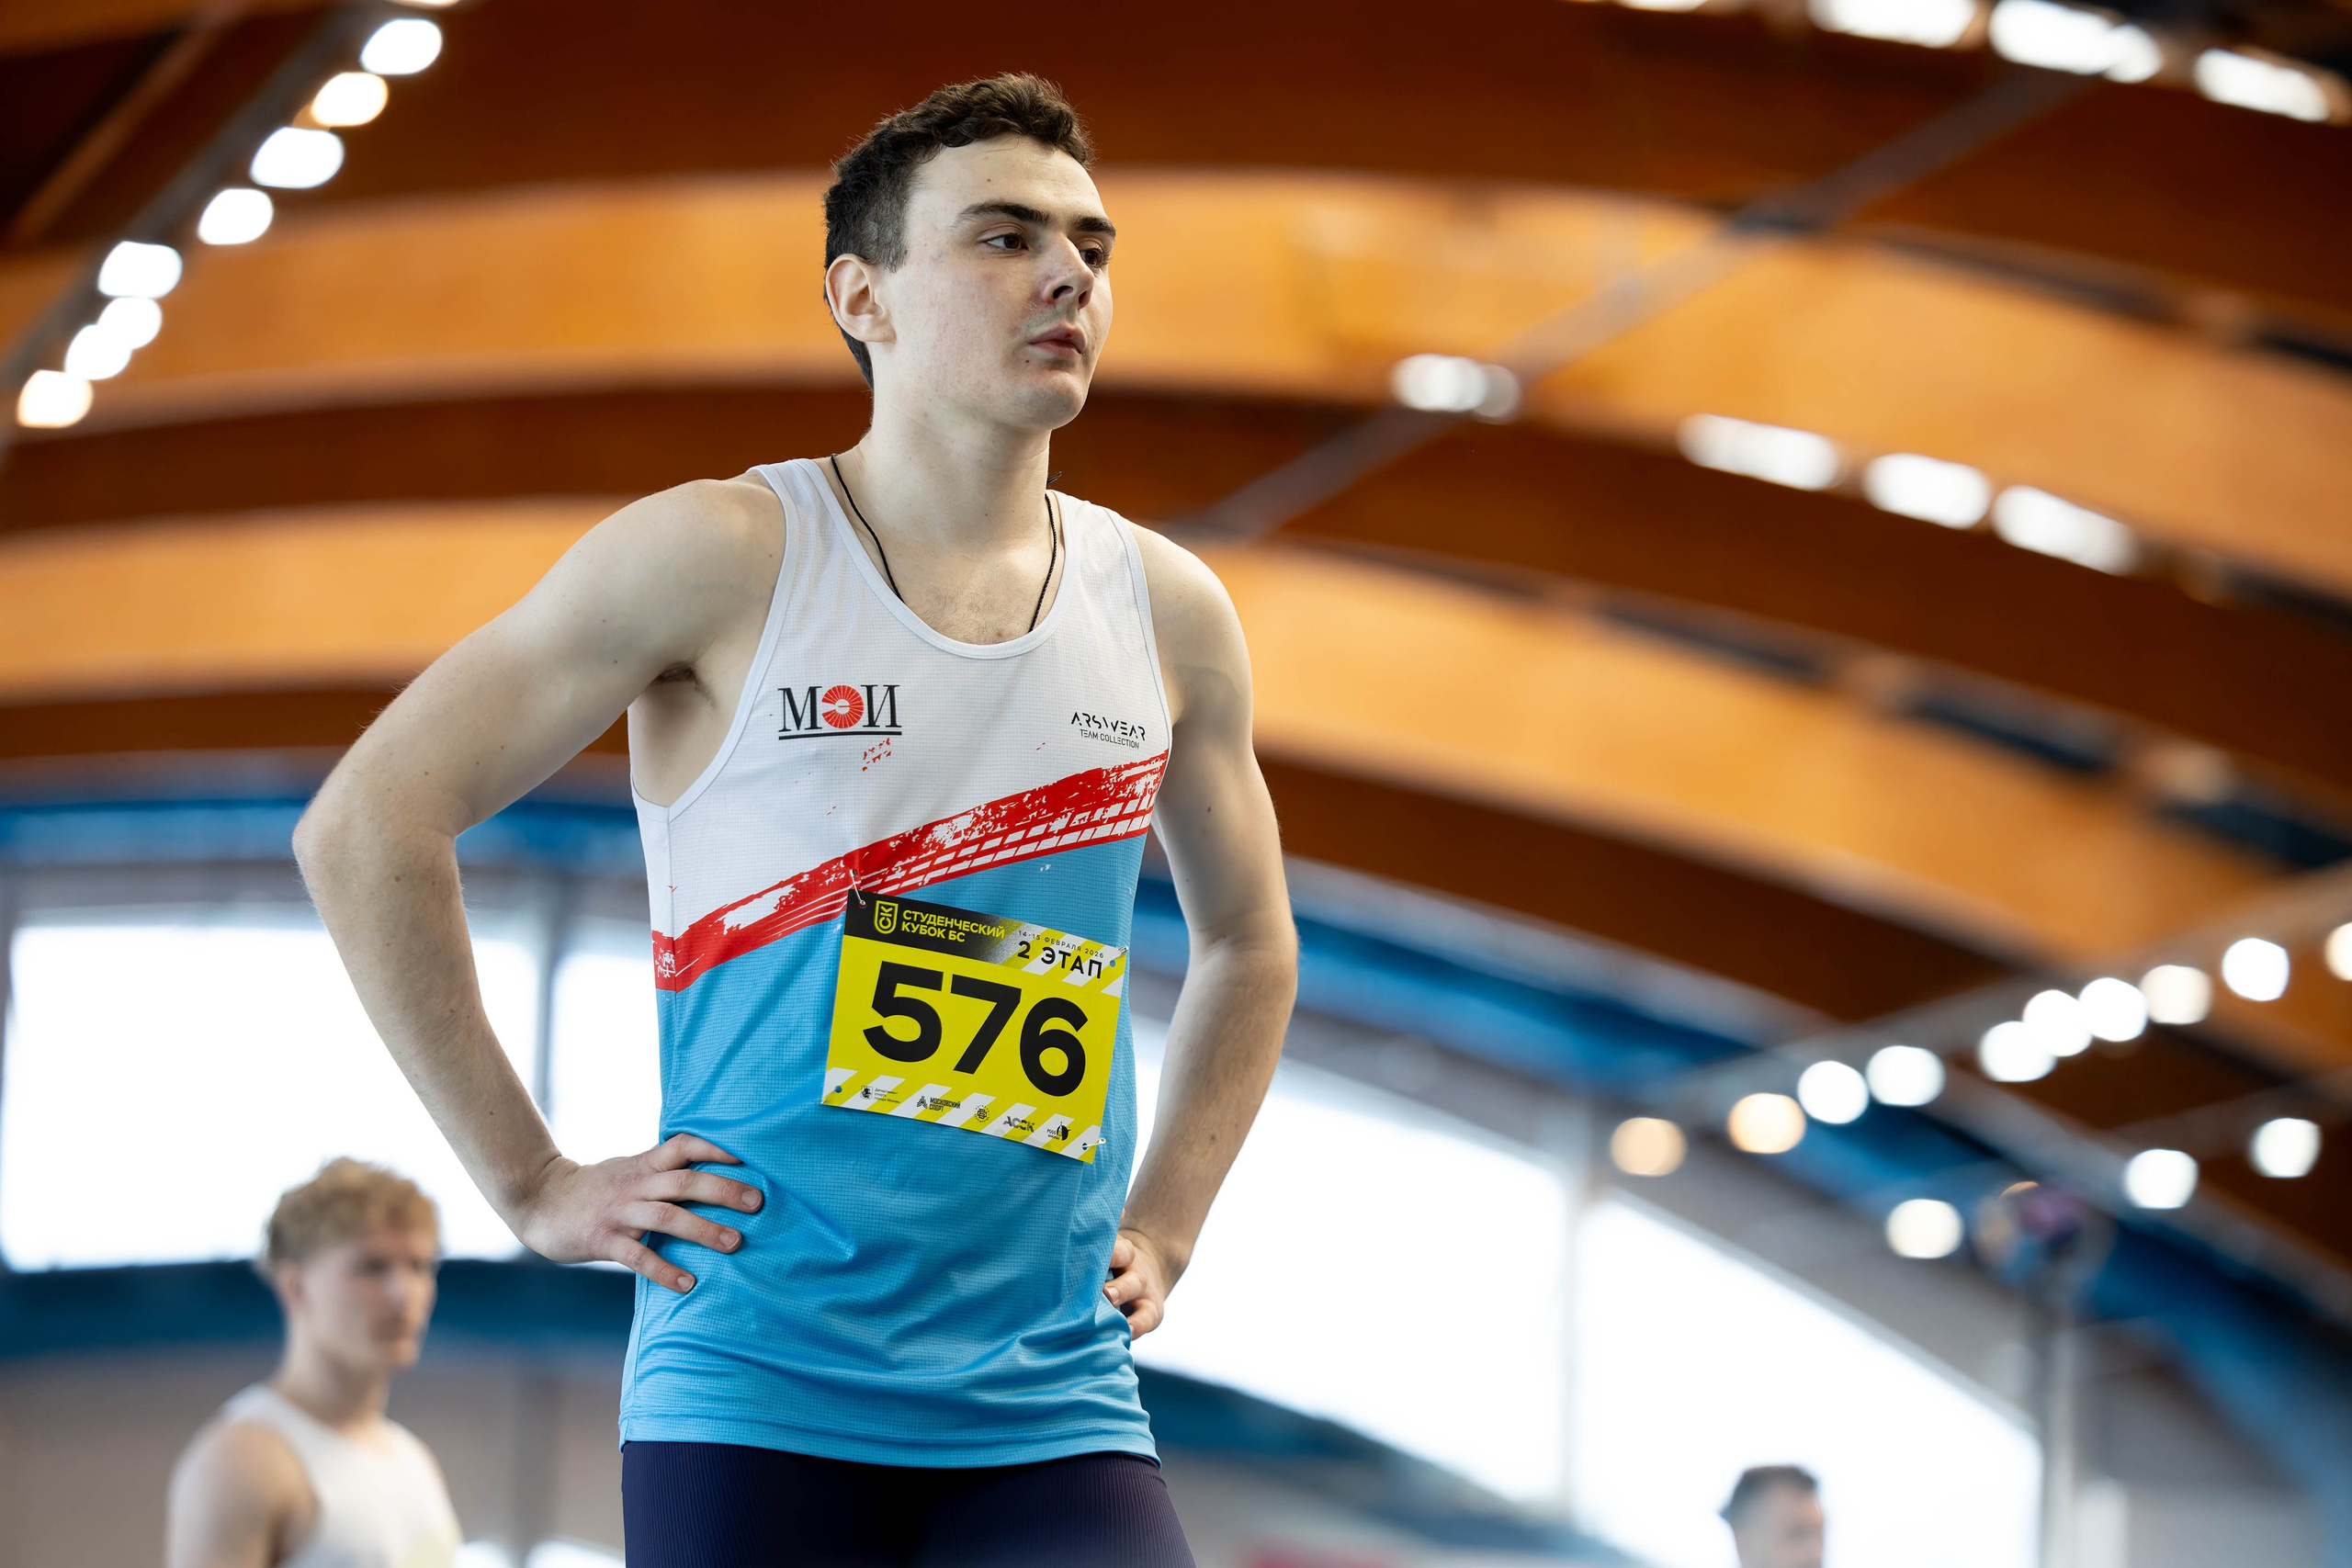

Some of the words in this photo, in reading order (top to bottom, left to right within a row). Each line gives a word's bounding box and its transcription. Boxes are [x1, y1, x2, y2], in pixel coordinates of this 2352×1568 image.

[777, 684, 902, 732] МЭИ
[1070, 711, 1146, 741] ARSWEAR
[1080, 728, 1099, 740] TEAM
[1100, 733, 1140, 750] COLLECTION
[901, 920, 946, 939] КУБОК
[947, 930, 966, 942] БС
[902, 908, 1005, 939] СТУДЕНЧЕСКИЙ
[1017, 940, 1031, 960] 2
[1041, 946, 1102, 979] ЭТАП
[1018, 930, 1041, 941] 14-15
[1044, 936, 1081, 953] ФЕВРАЛЯ
[1084, 948, 1104, 959] 2026
[863, 960, 1088, 1097] 576
